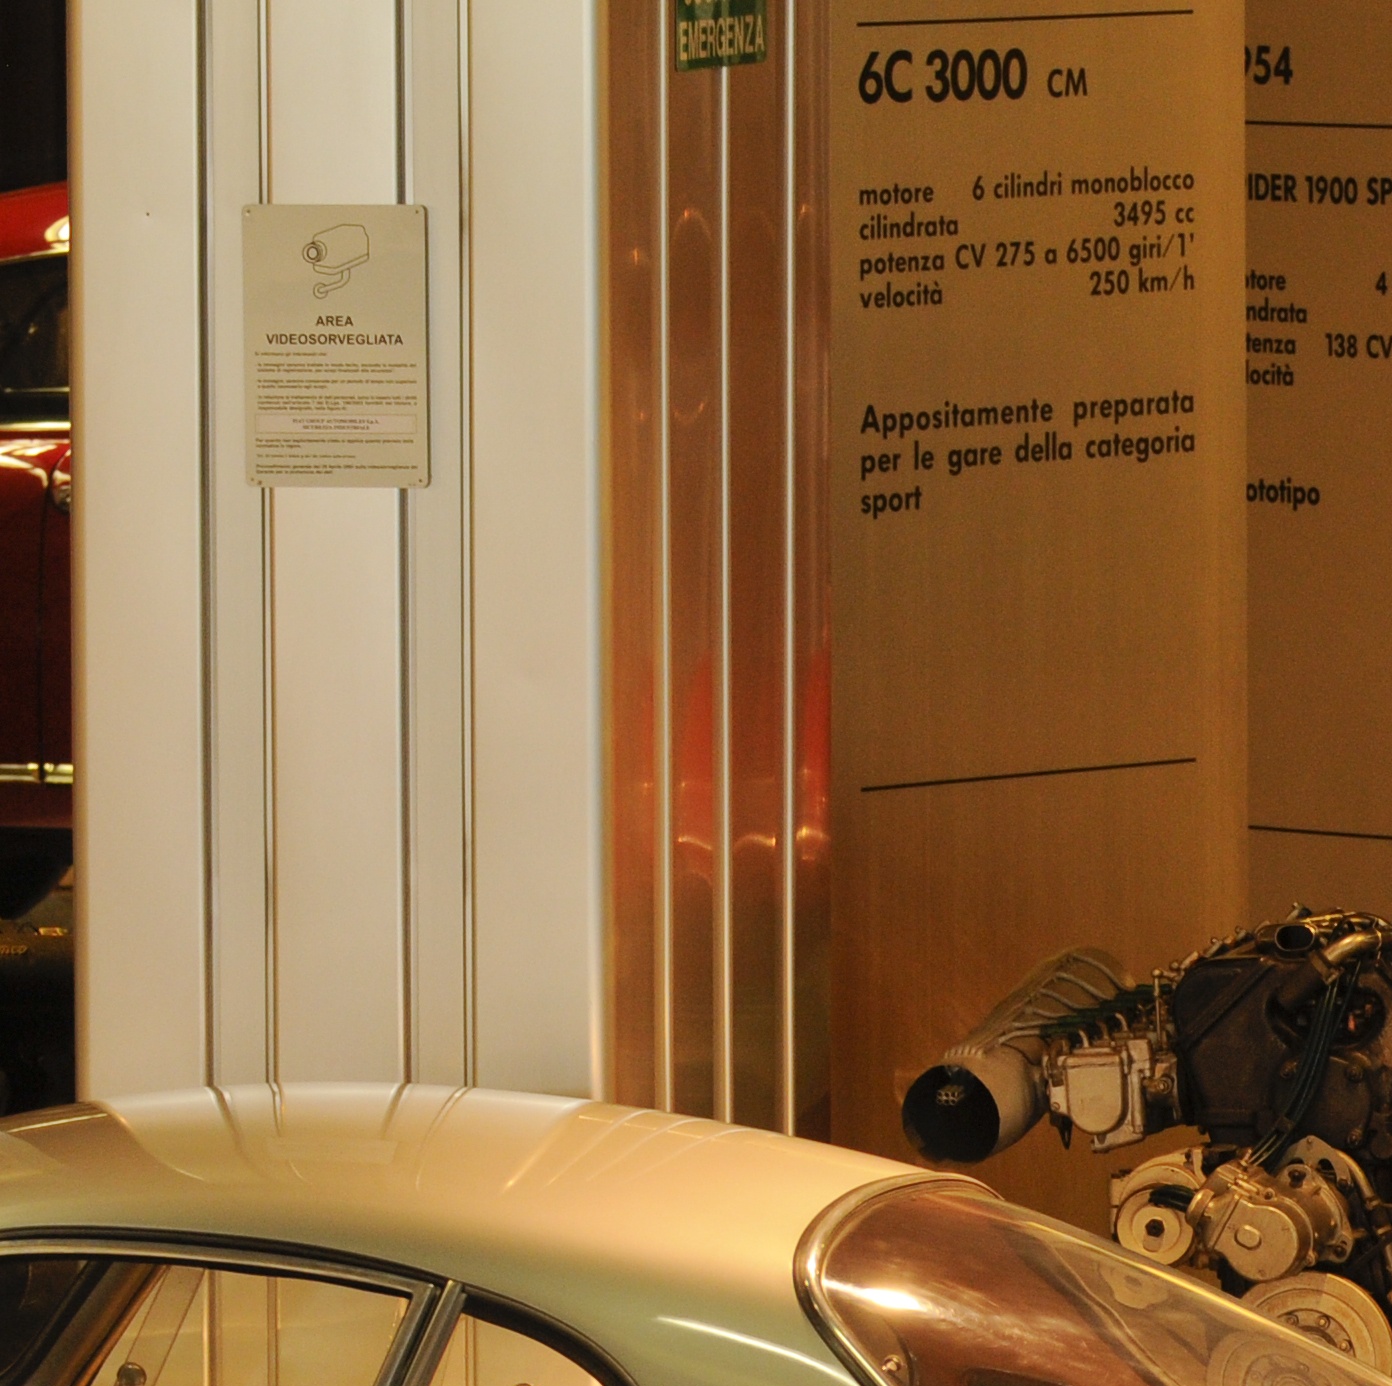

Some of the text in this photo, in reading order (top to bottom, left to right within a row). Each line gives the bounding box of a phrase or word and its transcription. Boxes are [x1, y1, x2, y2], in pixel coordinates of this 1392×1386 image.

[679, 14, 765, 60] EMERGENZA
[857, 47, 1089, 105] 6C 3000 CM
[858, 165, 1195, 206] motore 6 cilindri monoblocco
[1245, 172, 1299, 203] IDER
[1304, 174, 1359, 206] 1900
[858, 199, 1195, 241] cilindrata 3495 cc
[859, 251, 945, 282] potenza
[954, 242, 987, 271] CV
[995, 240, 1036, 268] 275
[1043, 247, 1058, 266] a
[1065, 235, 1121, 265] 6500
[859, 263, 1196, 309] velocità 250 km/h
[1374, 270, 1389, 297] 4
[314, 314, 355, 328] AREA
[1245, 296, 1308, 325] ndrata
[265, 332, 404, 347] VIDEOSORVEGLIATA
[1246, 331, 1297, 356] tenza
[1324, 332, 1359, 359] 138
[1246, 358, 1295, 387] locità
[859, 389, 1195, 440] Appositamente preparata
[860, 425, 1196, 482] per le gare della categoria
[860, 485, 923, 521] sport
[1246, 477, 1321, 512] ototipo
